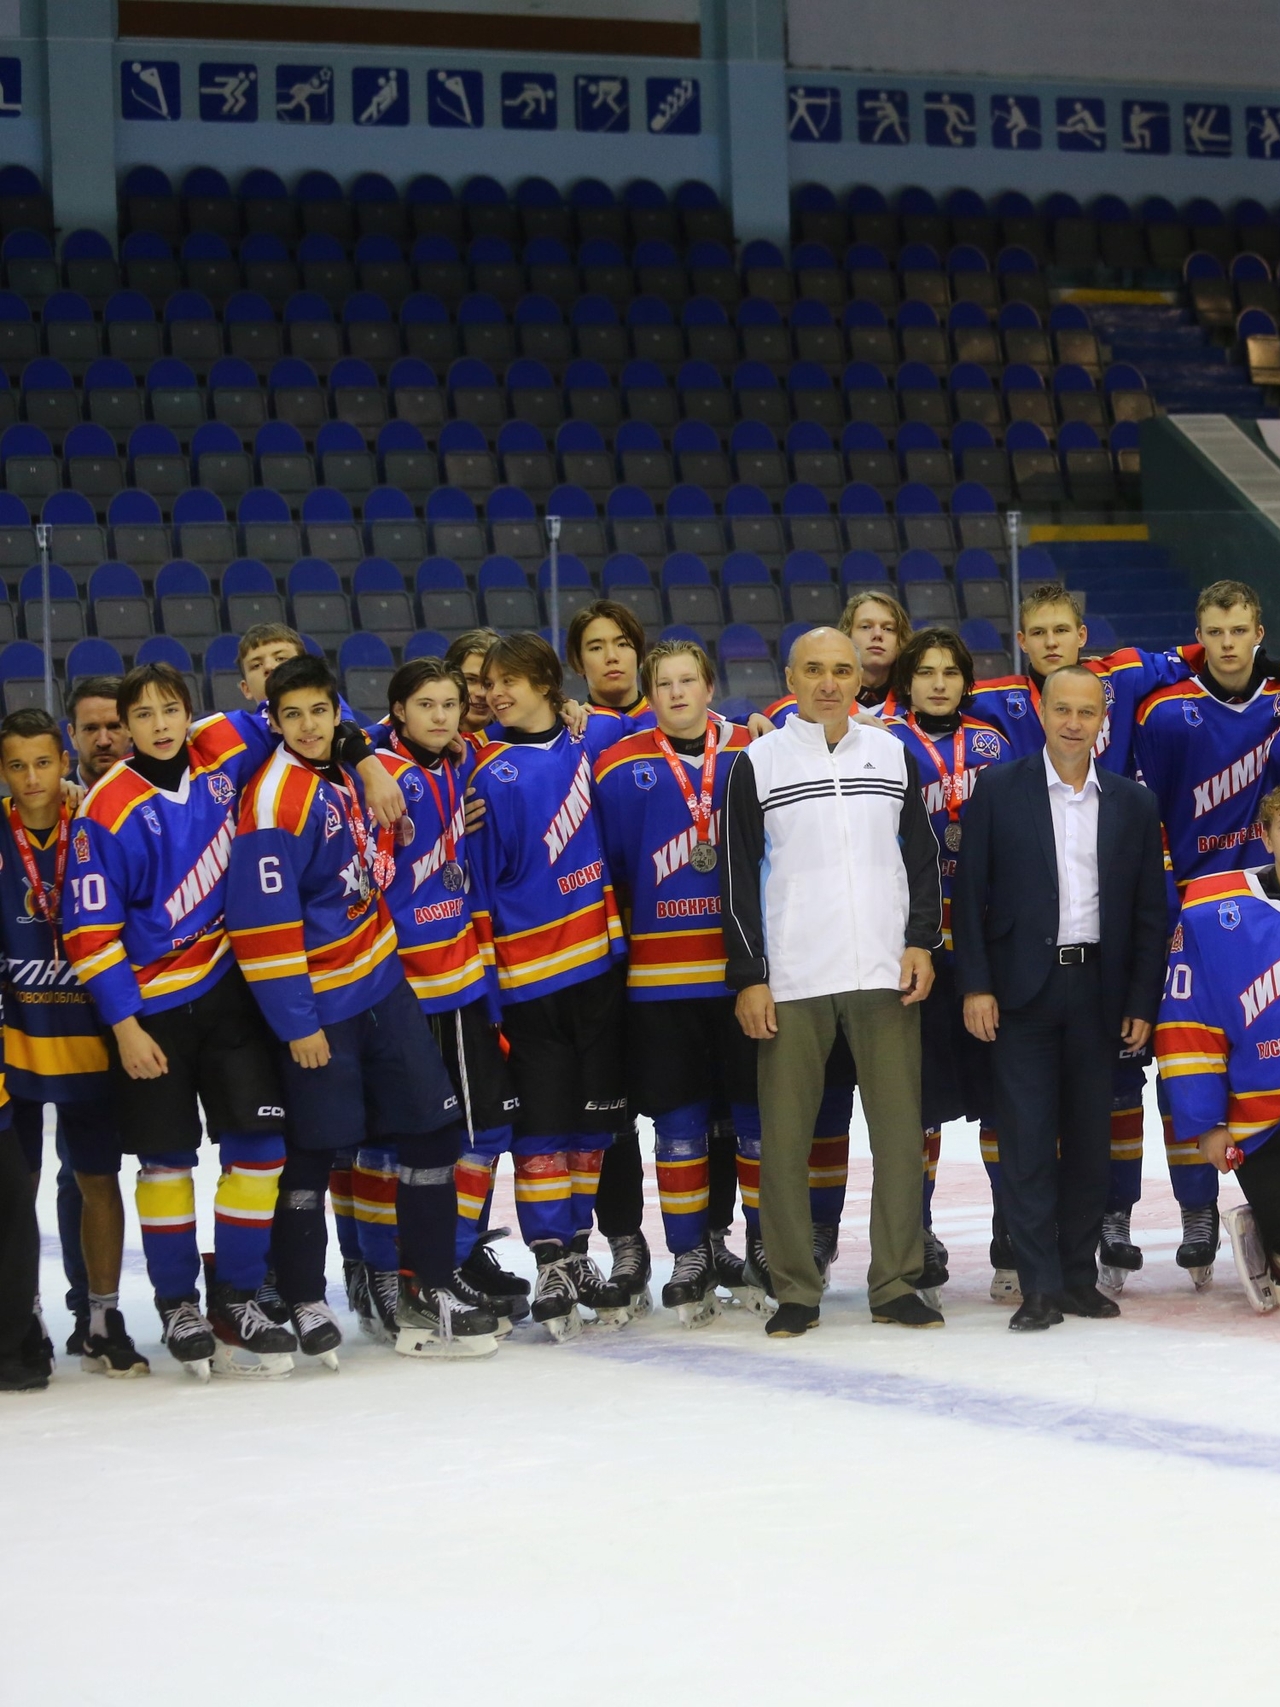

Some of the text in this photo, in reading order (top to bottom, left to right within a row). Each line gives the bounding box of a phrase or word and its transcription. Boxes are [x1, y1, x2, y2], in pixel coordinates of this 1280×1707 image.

[542, 751, 592, 867] ХИМИ
[164, 808, 238, 931] ХИМИ
[258, 855, 284, 895] 6
[557, 858, 605, 896] ВОСКР
[656, 895, 722, 920] ВОСКРЕС
[584, 1097, 628, 1111] BAUE
